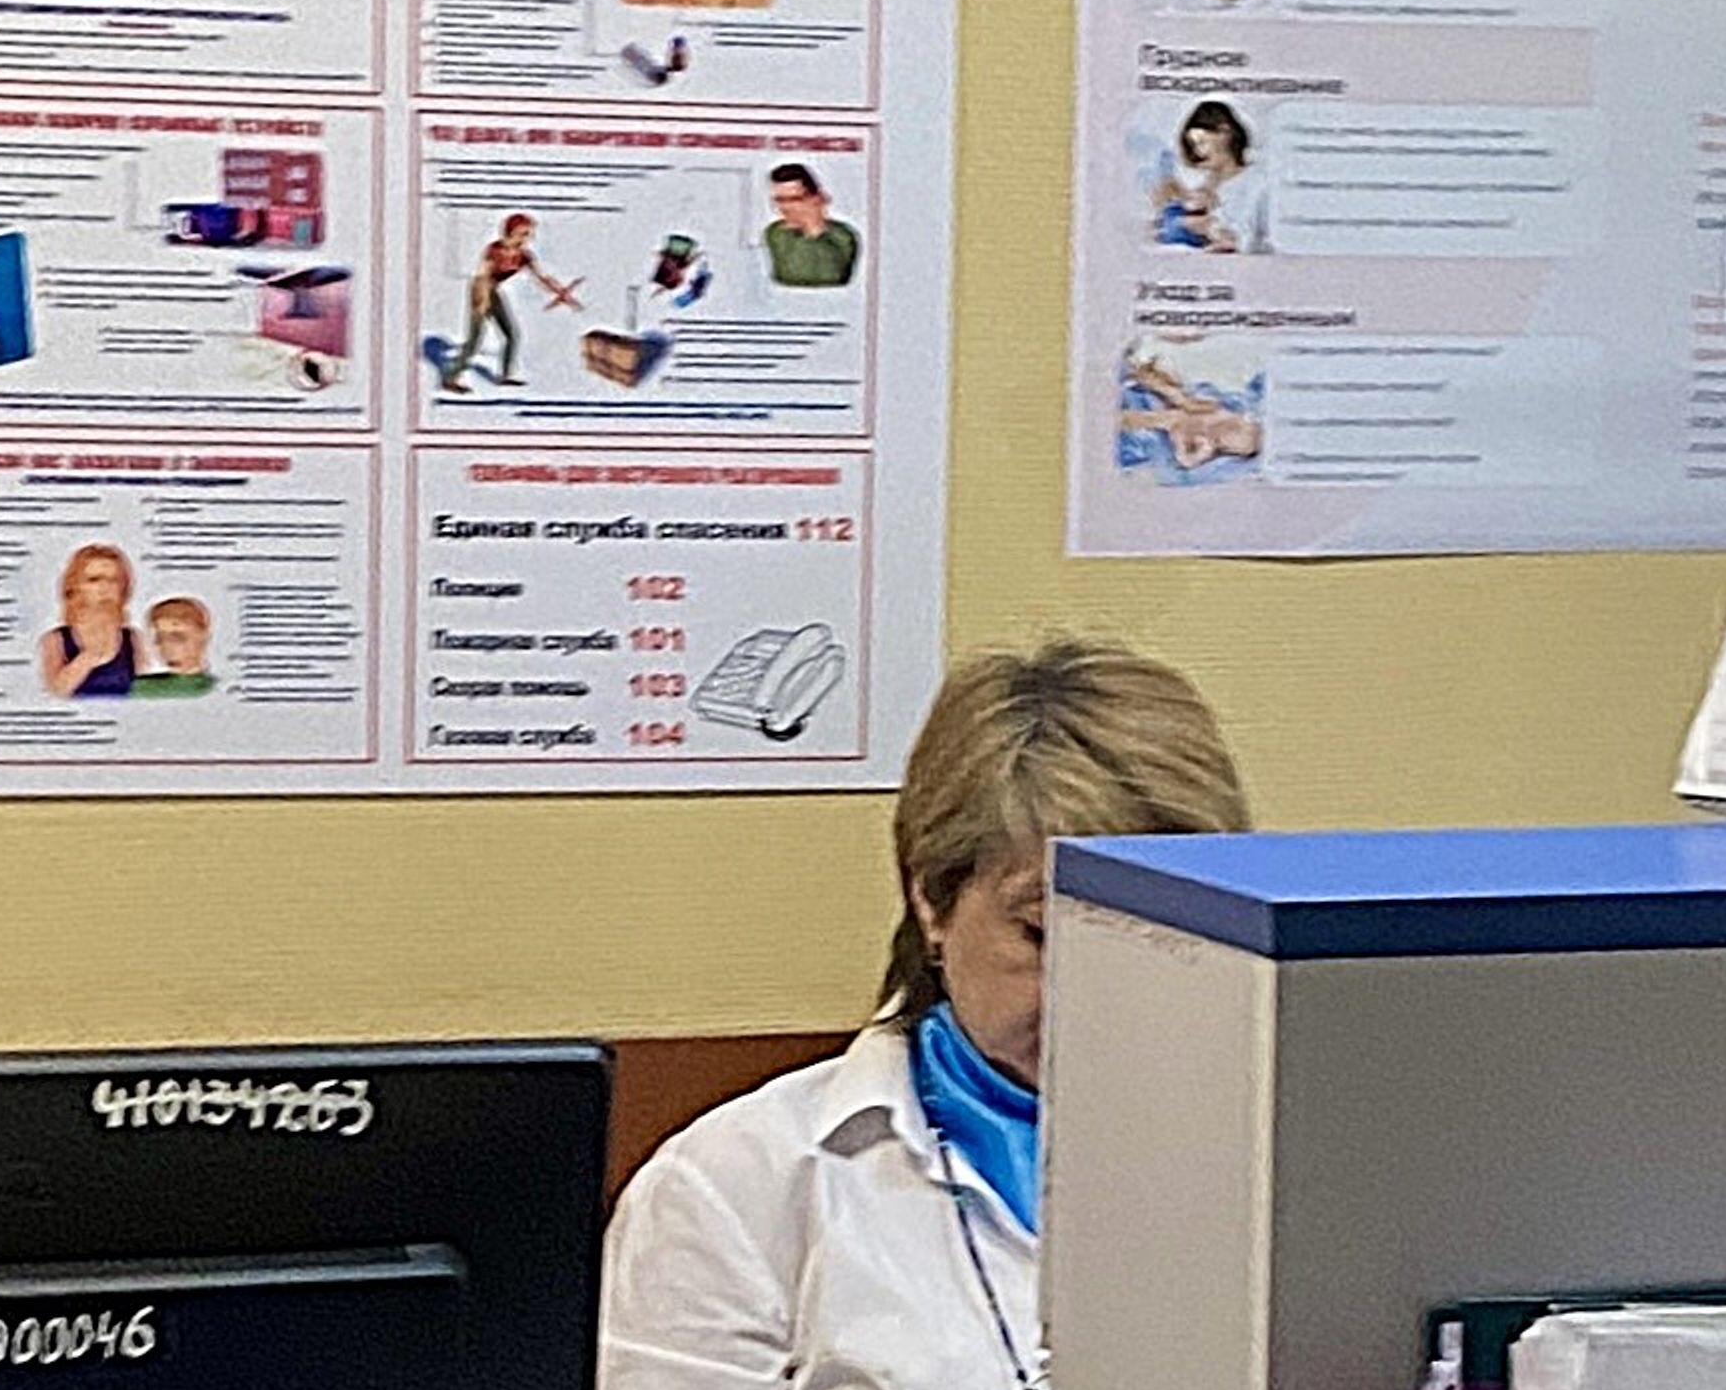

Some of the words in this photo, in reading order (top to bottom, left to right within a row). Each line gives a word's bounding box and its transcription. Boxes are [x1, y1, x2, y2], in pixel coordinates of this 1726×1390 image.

[431, 515, 535, 540] Единая
[545, 516, 649, 544] служба
[655, 521, 790, 541] спасения
[795, 518, 855, 541] 112
[625, 576, 687, 601] 102
[627, 627, 687, 651] 101
[627, 674, 687, 699] 103
[625, 721, 687, 747] 104
